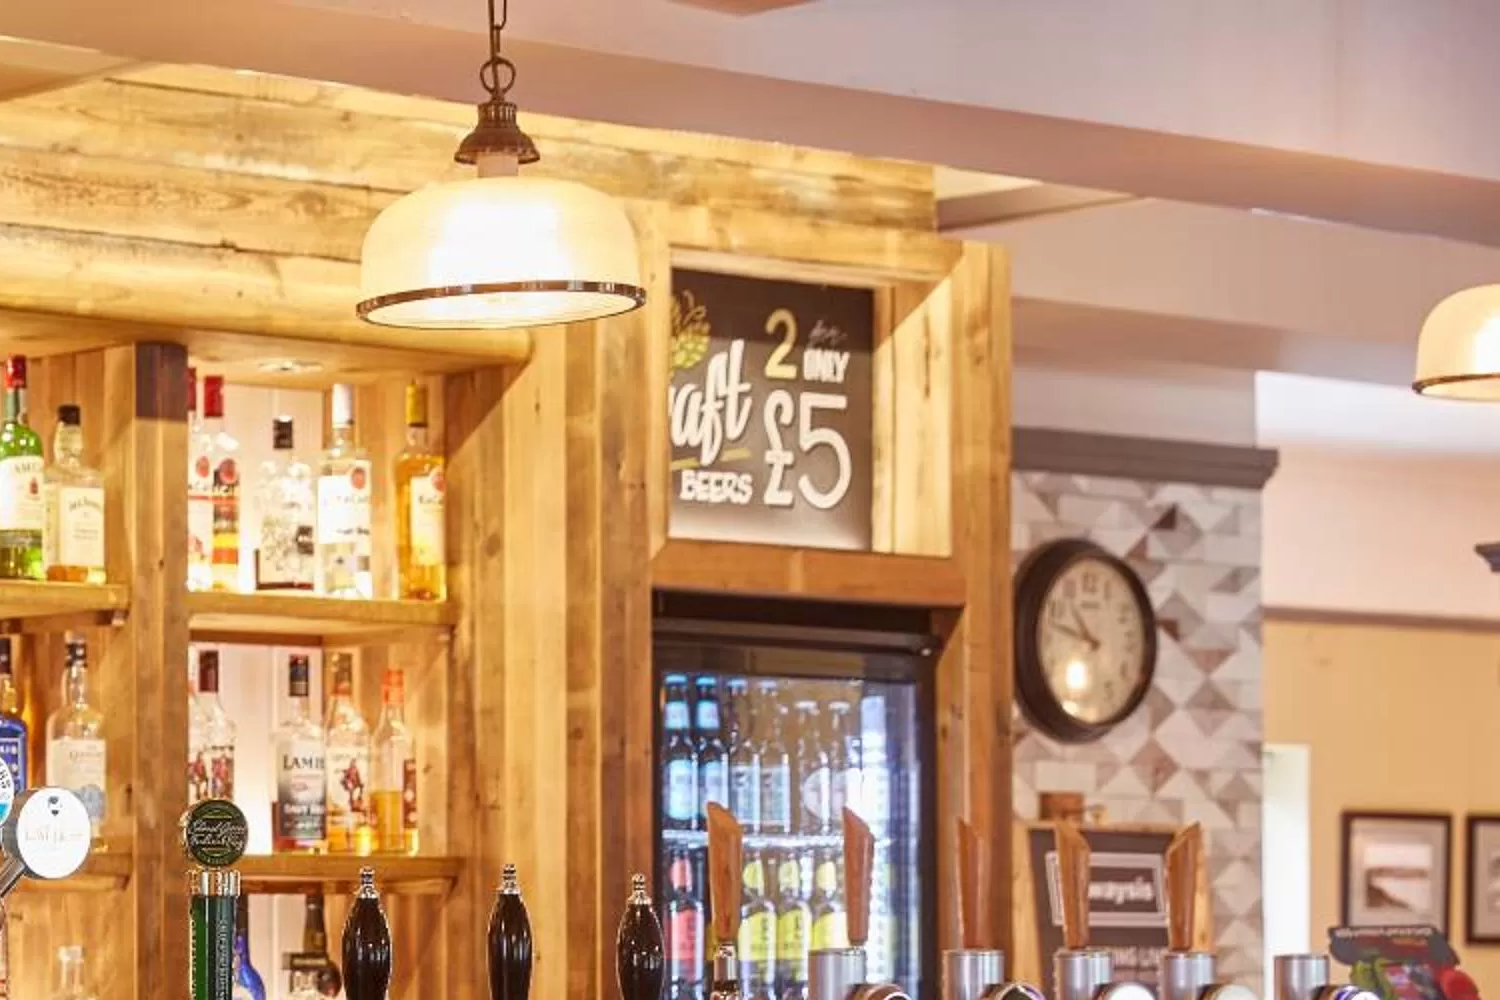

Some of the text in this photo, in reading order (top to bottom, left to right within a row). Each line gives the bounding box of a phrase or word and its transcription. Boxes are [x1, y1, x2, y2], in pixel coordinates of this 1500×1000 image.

[764, 308, 797, 380] 2
[803, 347, 850, 383] ONLY
[763, 389, 851, 509] £5
[680, 468, 752, 504] BEERS
